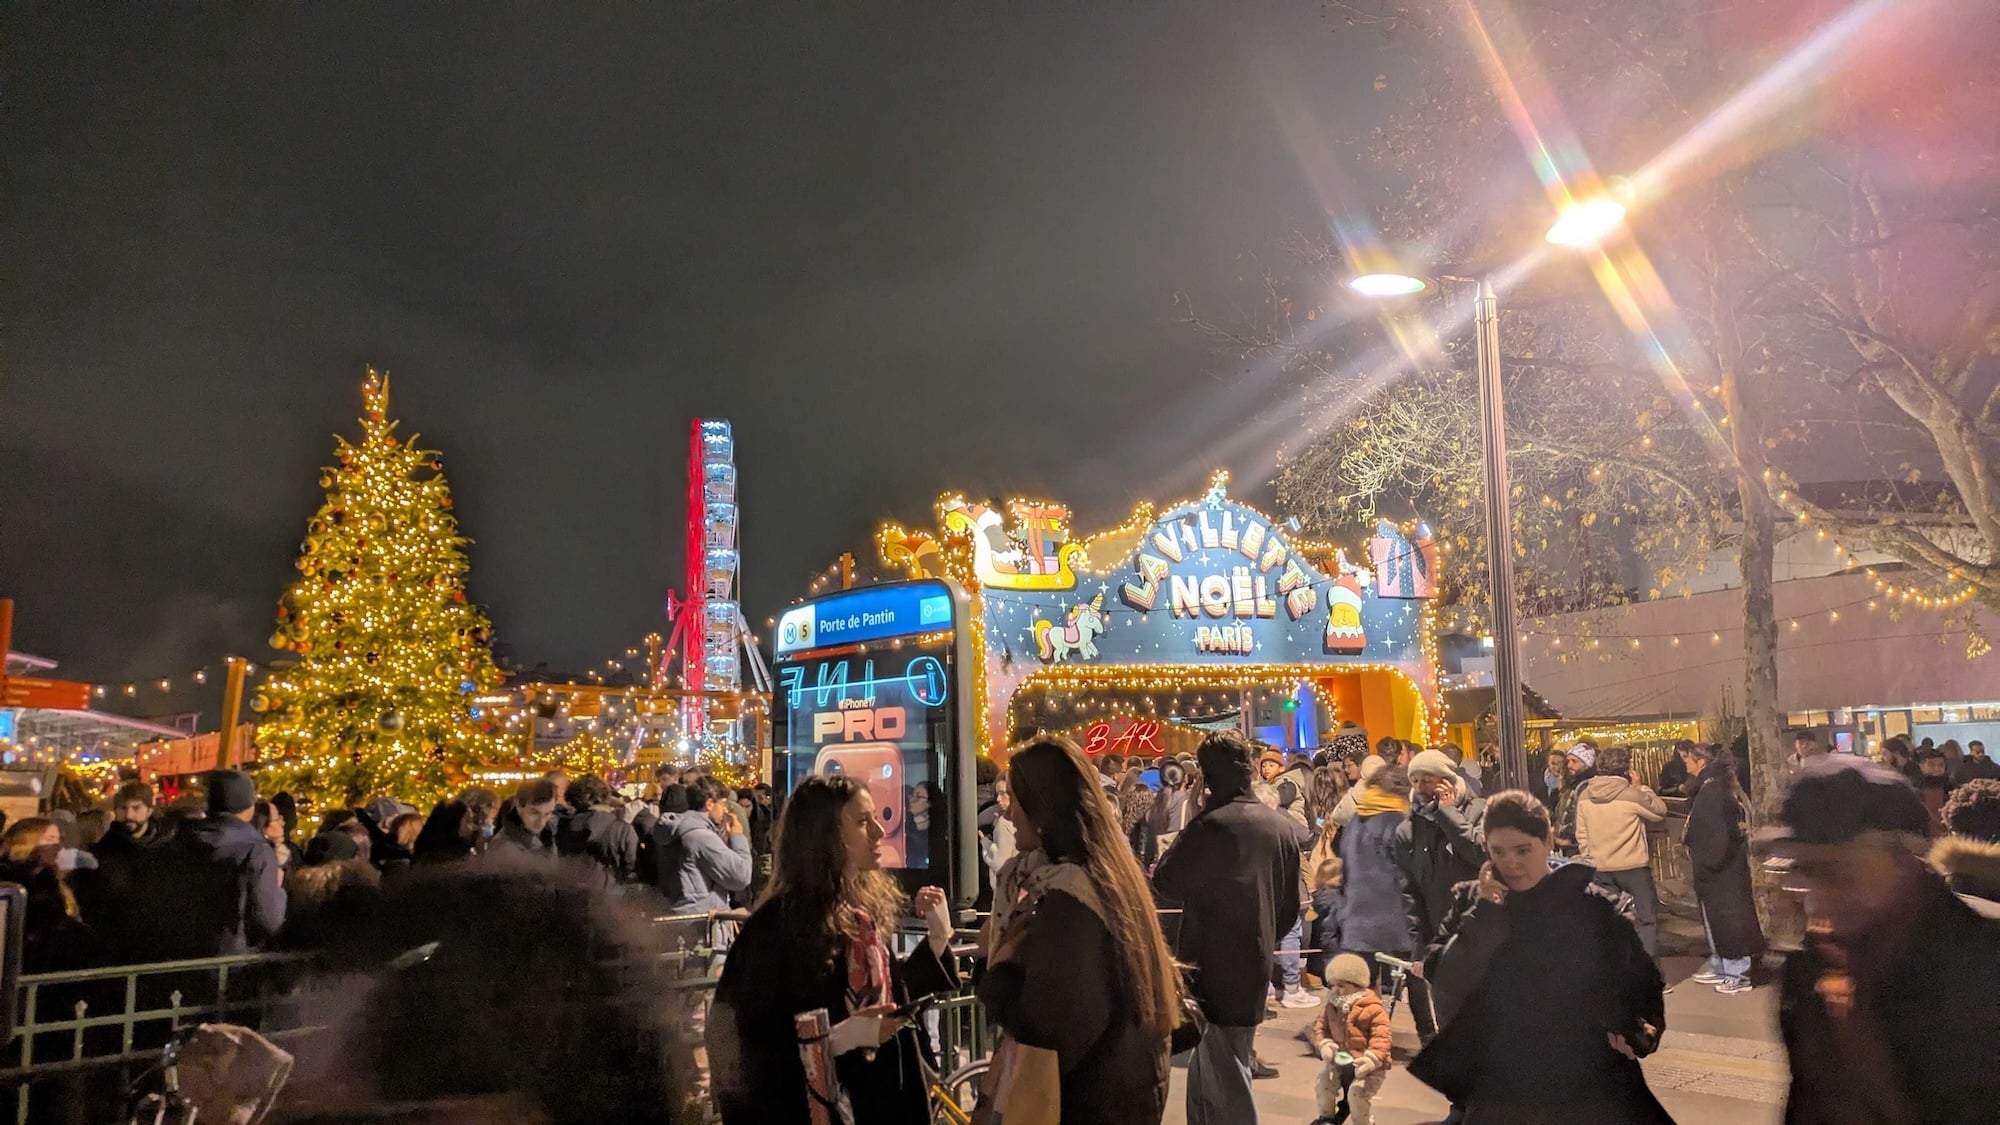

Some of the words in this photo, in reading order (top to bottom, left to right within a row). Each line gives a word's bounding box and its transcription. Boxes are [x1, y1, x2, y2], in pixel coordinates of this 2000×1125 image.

[1124, 552, 1169, 610] LA
[1152, 509, 1318, 621] VILLETTE
[1170, 565, 1277, 618] NOËL
[800, 623, 809, 638] 5
[819, 616, 846, 634] Porte
[848, 613, 860, 629] de
[862, 609, 895, 627] Pantin
[1196, 625, 1254, 655] PARIS
[843, 697, 868, 710] iPhone
[814, 707, 905, 743] PRO
[1085, 722, 1165, 754] BAR
